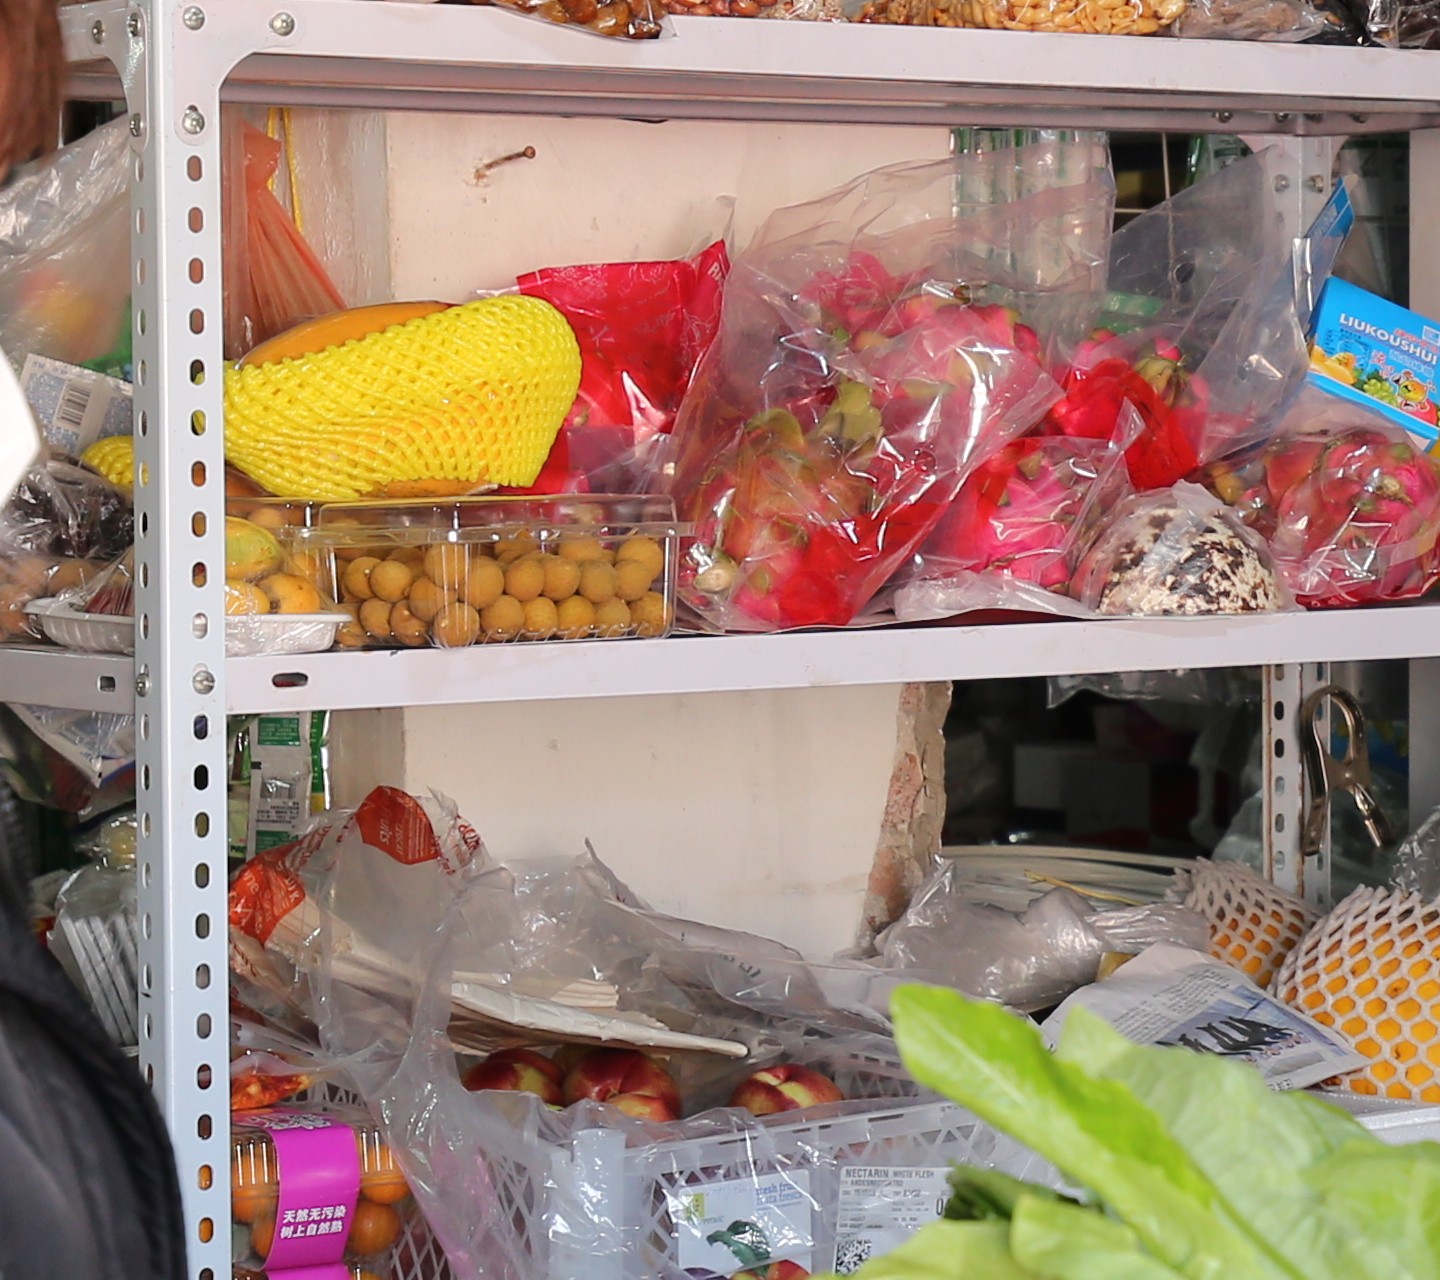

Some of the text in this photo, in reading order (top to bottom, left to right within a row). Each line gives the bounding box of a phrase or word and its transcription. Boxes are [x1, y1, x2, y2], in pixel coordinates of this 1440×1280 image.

[1339, 312, 1439, 366] LIUKOUSHUI
[845, 1168, 890, 1179] NECTARIN
[282, 1205, 347, 1224] 天然无污染
[279, 1220, 343, 1239] 树上自然熟
